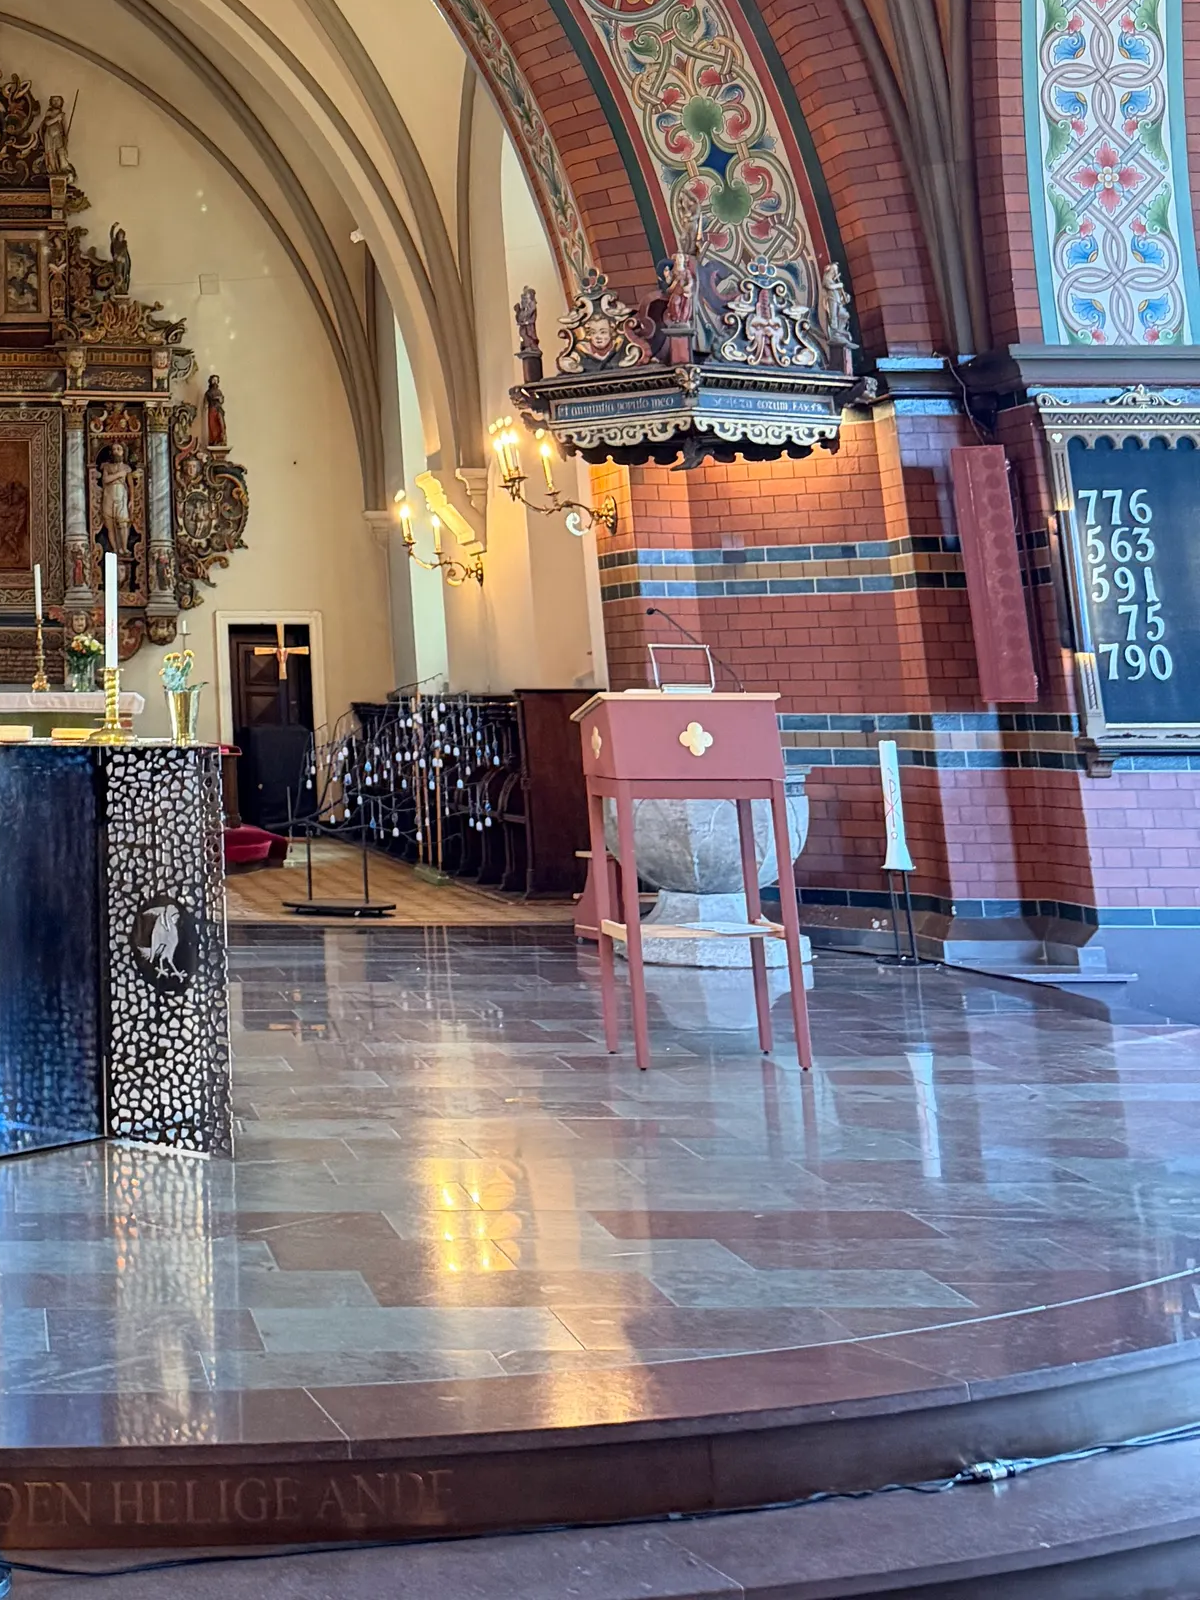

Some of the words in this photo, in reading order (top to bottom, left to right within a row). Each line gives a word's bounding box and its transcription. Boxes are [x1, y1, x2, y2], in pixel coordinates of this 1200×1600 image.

[1078, 488, 1153, 525] 776
[1086, 525, 1155, 564] 563
[1091, 564, 1160, 603] 591
[1118, 603, 1165, 642] 75
[1099, 643, 1173, 681] 790
[111, 1475, 301, 1525] HELIGE
[316, 1469, 454, 1521] ANDE
